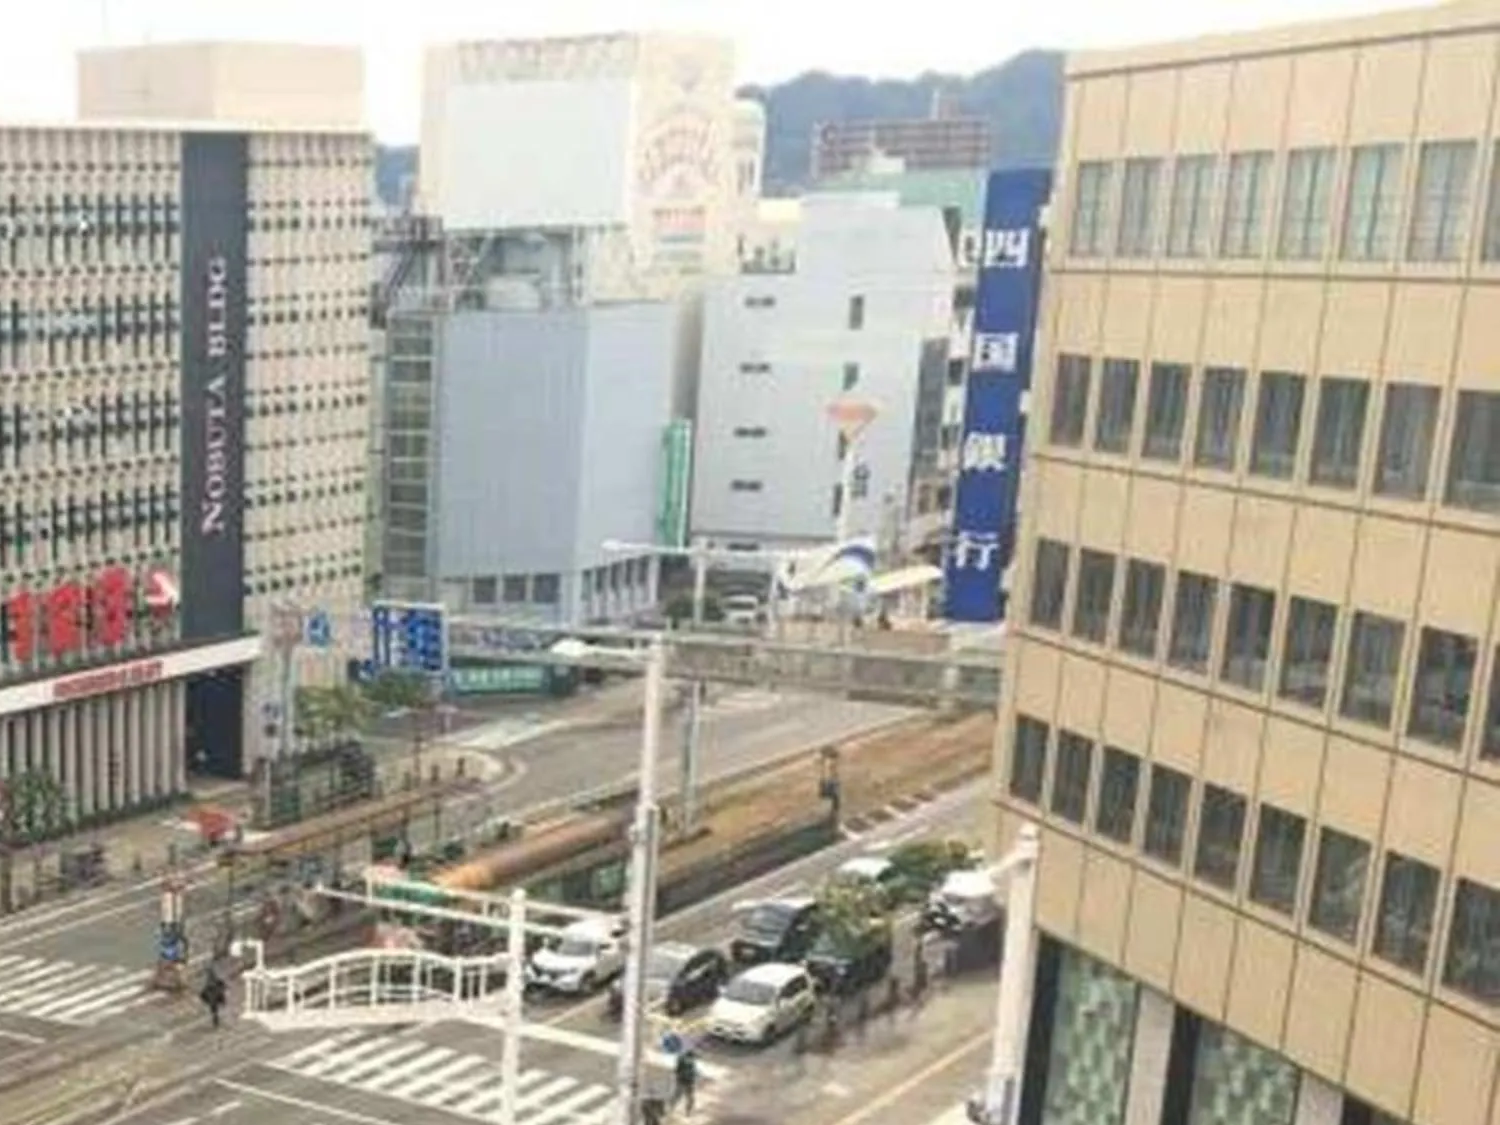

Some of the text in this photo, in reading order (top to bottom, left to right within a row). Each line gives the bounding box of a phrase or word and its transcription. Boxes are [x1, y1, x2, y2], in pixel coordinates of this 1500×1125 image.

[202, 256, 227, 536] NOBUTA BLDG
[955, 227, 1031, 570] 四国銀行
